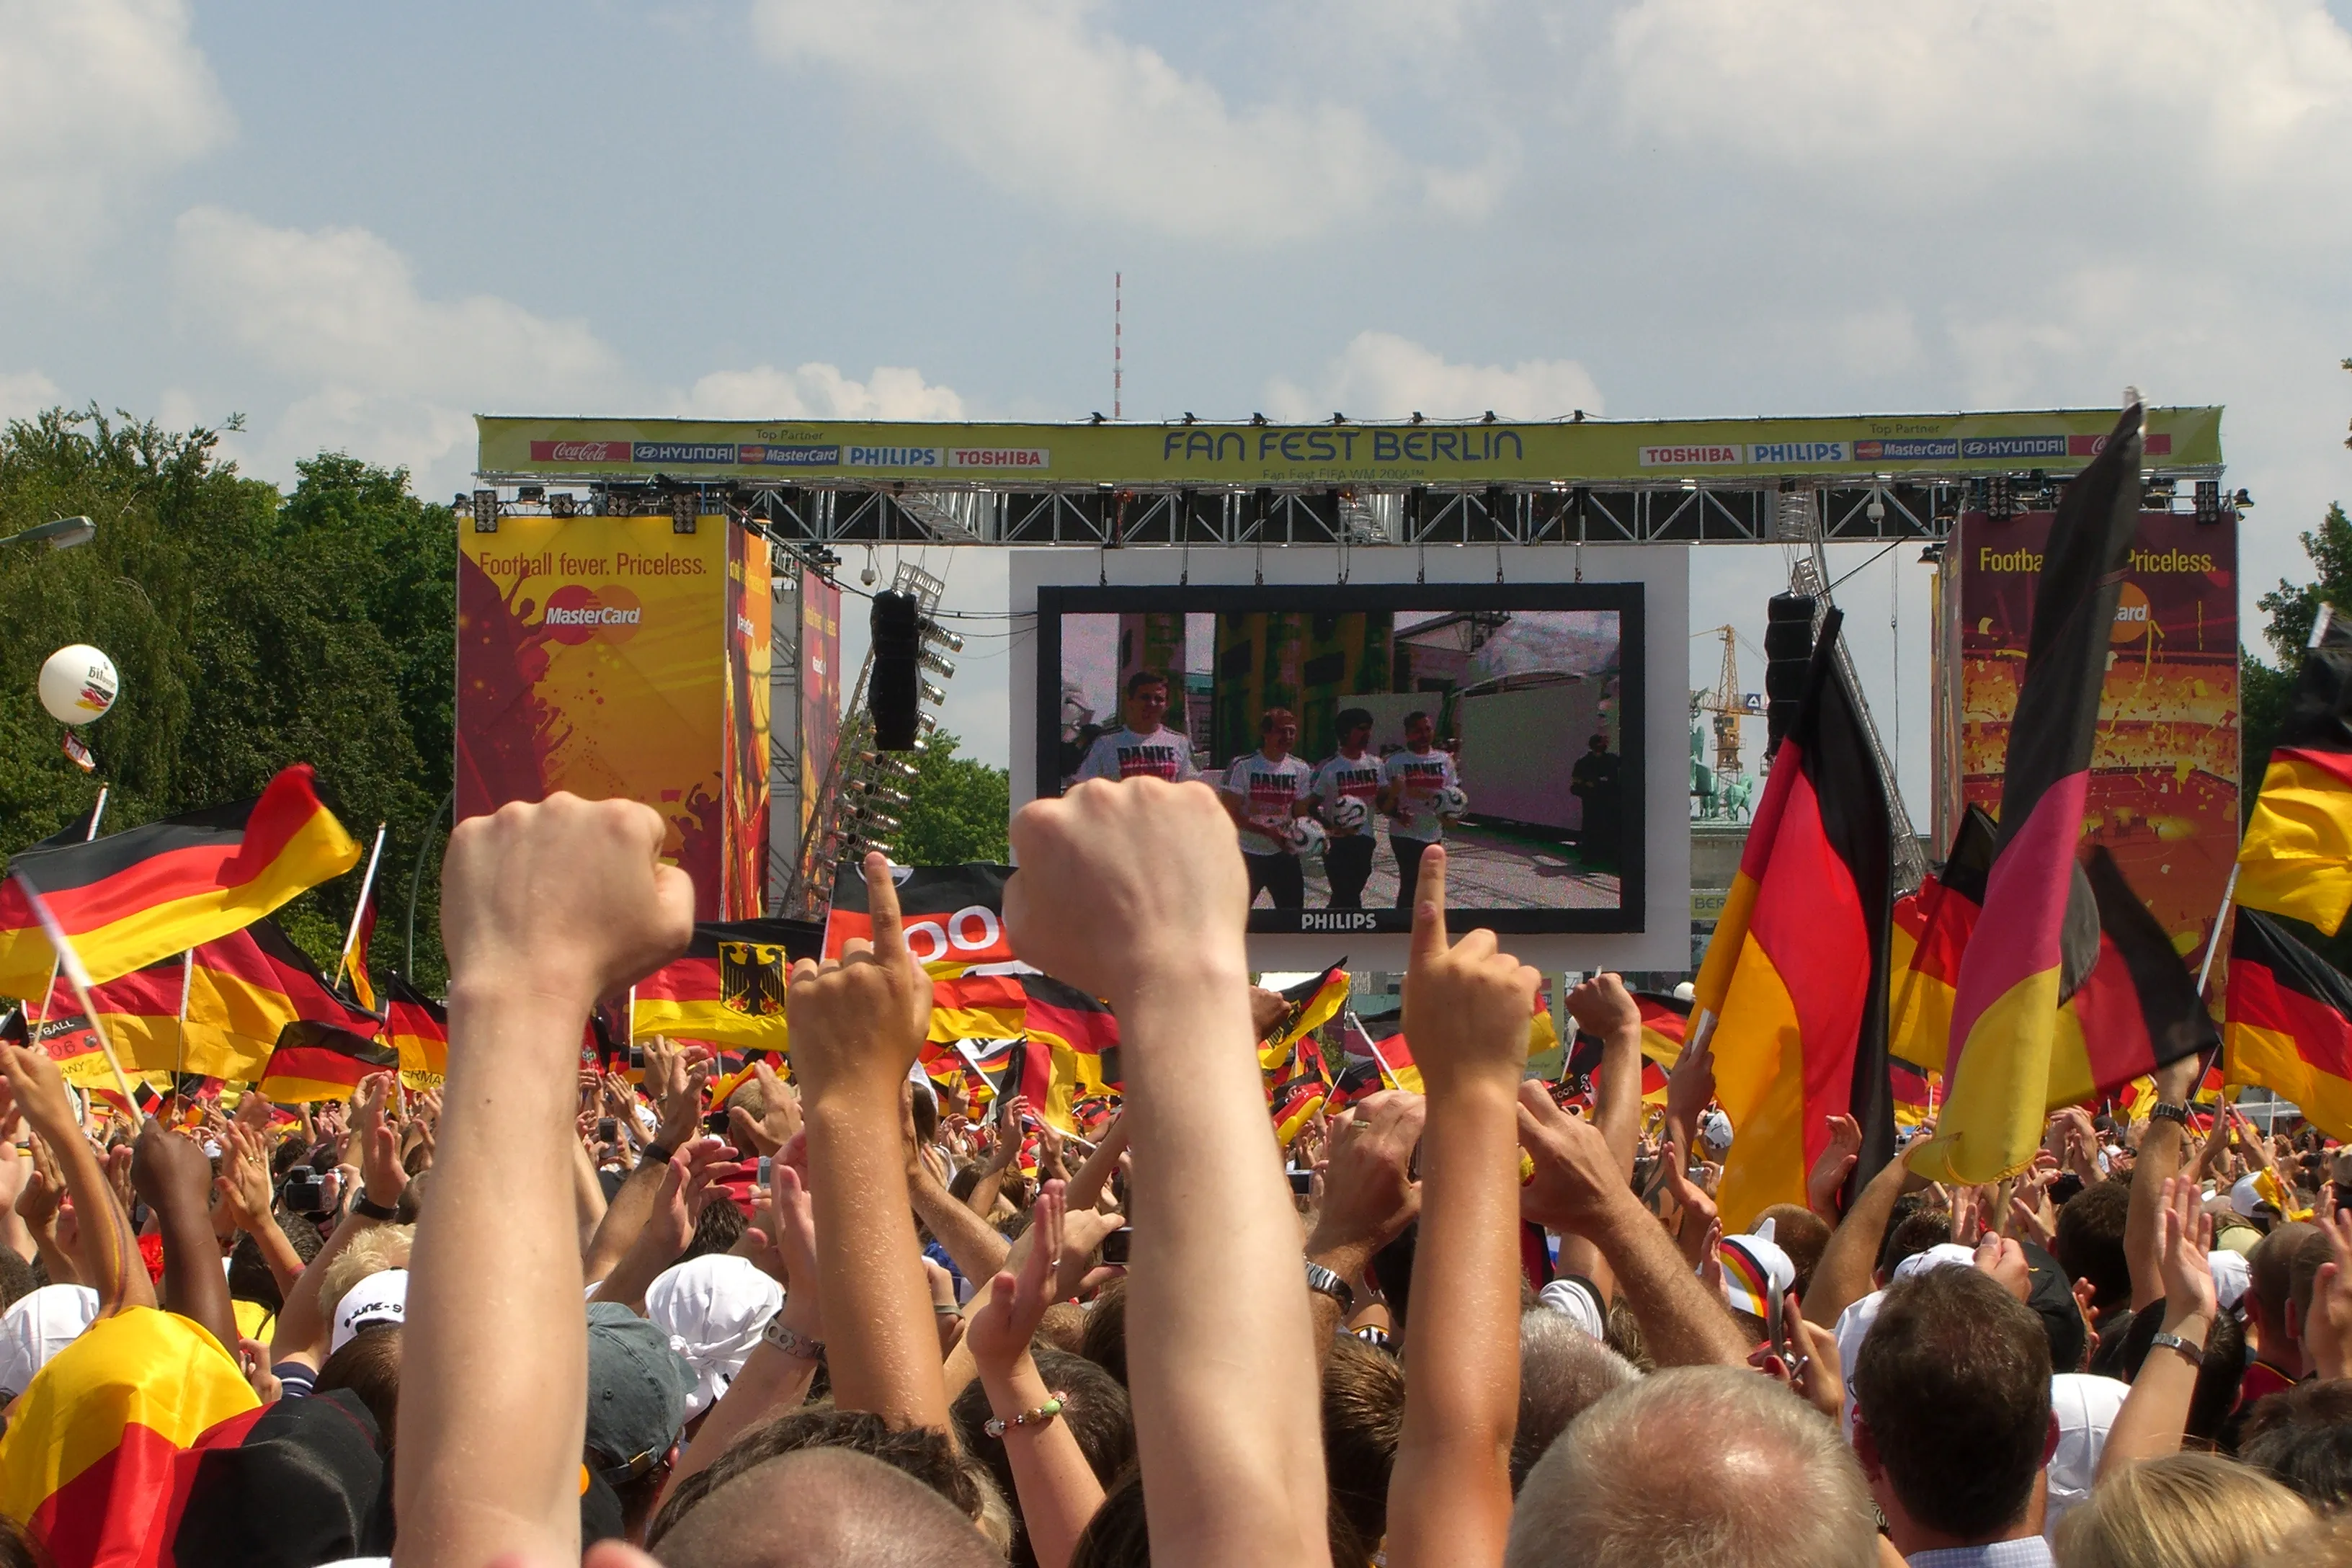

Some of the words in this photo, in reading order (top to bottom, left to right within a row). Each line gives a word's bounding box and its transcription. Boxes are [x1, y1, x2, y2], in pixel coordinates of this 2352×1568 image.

[756, 429, 778, 441] Top
[780, 429, 824, 440] Partner
[1869, 423, 1892, 436] Top
[1896, 423, 1940, 434] Partner
[661, 446, 734, 460] HYUNDAI
[1164, 431, 1245, 461] FAN
[1259, 431, 1360, 461] FEST
[1373, 429, 1523, 461] BERLIN
[1755, 443, 1843, 462] PHILIPS
[1884, 442, 1956, 456] MasterCard
[1989, 440, 2064, 454] HYUNDAI
[766, 449, 838, 462] MasterCard
[850, 447, 936, 466] PHILIPS
[956, 450, 1041, 466] TOSHIBA
[1647, 447, 1735, 463] TOSHIBA
[1319, 468, 1347, 480] FIFA
[1350, 468, 1376, 480] WM
[479, 551, 553, 576] Football
[559, 551, 610, 576] fever.
[616, 551, 708, 576] Priceless.
[545, 607, 642, 625] MasterCard
[2113, 604, 2147, 622] ard
[1118, 745, 1175, 762] DANKE
[1250, 772, 1296, 790] DANKE
[1337, 769, 1378, 786] DANKE
[1301, 912, 1377, 930] PHILIPS
